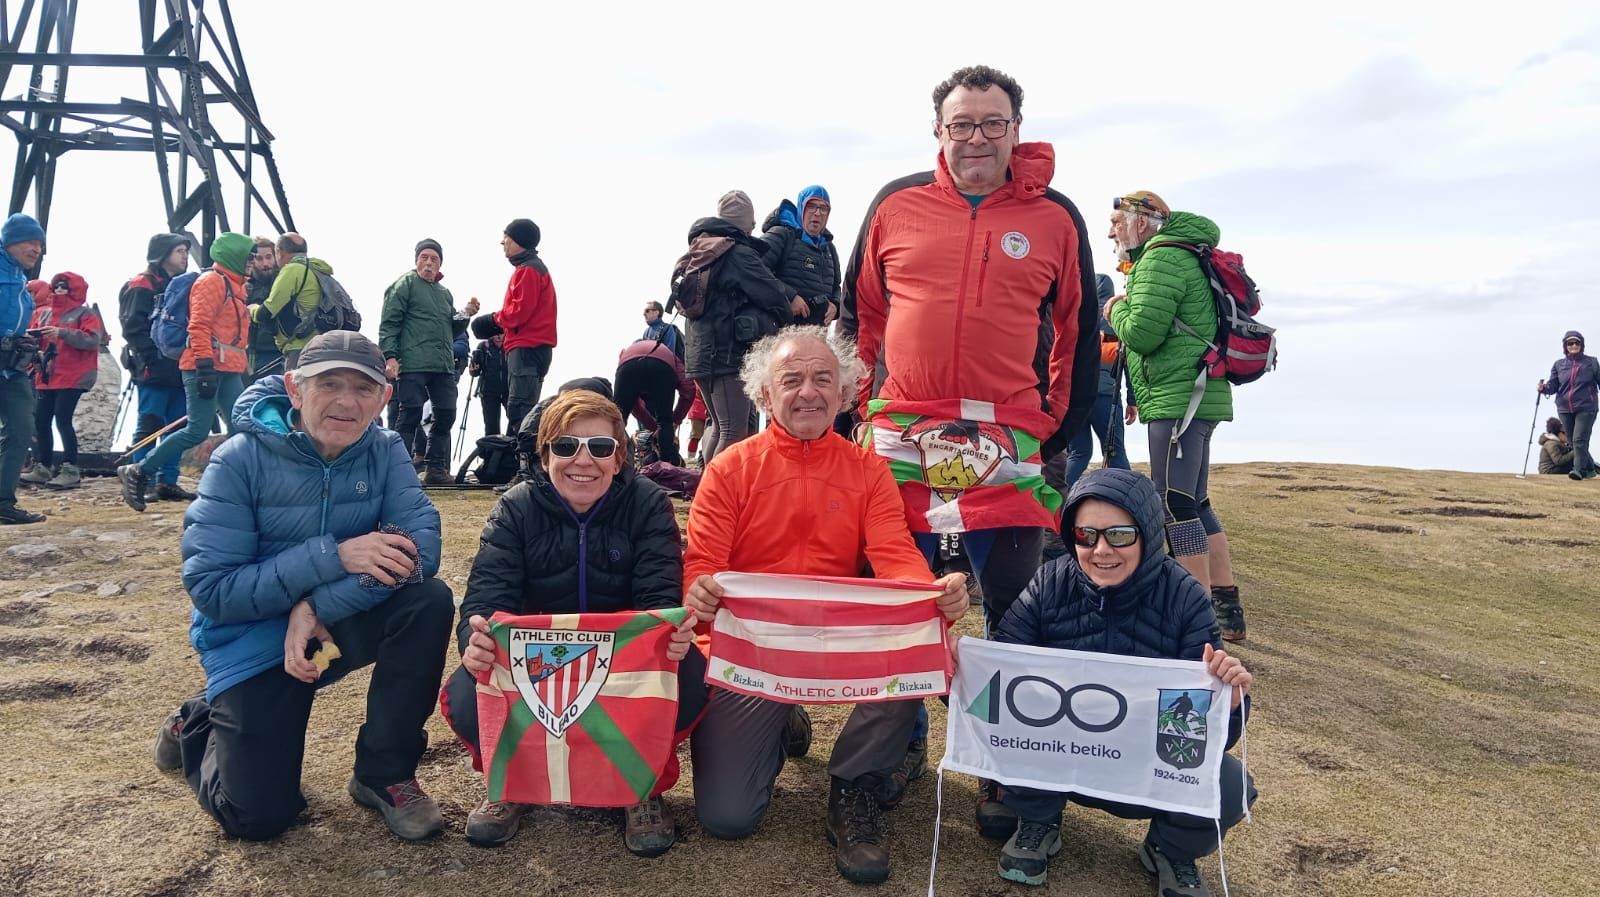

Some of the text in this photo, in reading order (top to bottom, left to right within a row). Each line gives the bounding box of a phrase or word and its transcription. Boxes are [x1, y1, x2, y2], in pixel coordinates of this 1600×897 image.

[928, 442, 989, 461] ENCARTACIONES
[949, 533, 960, 556] Fed
[513, 631, 611, 643] ATHLETIC CLUB
[733, 671, 765, 689] Bizkaia
[898, 681, 932, 692] Bizkaia
[774, 682, 879, 698] ATHLETIC CLUB
[966, 669, 1128, 733] 100
[989, 735, 1121, 760] Betidanik betiko
[1153, 768, 1200, 786] 1924-2024
